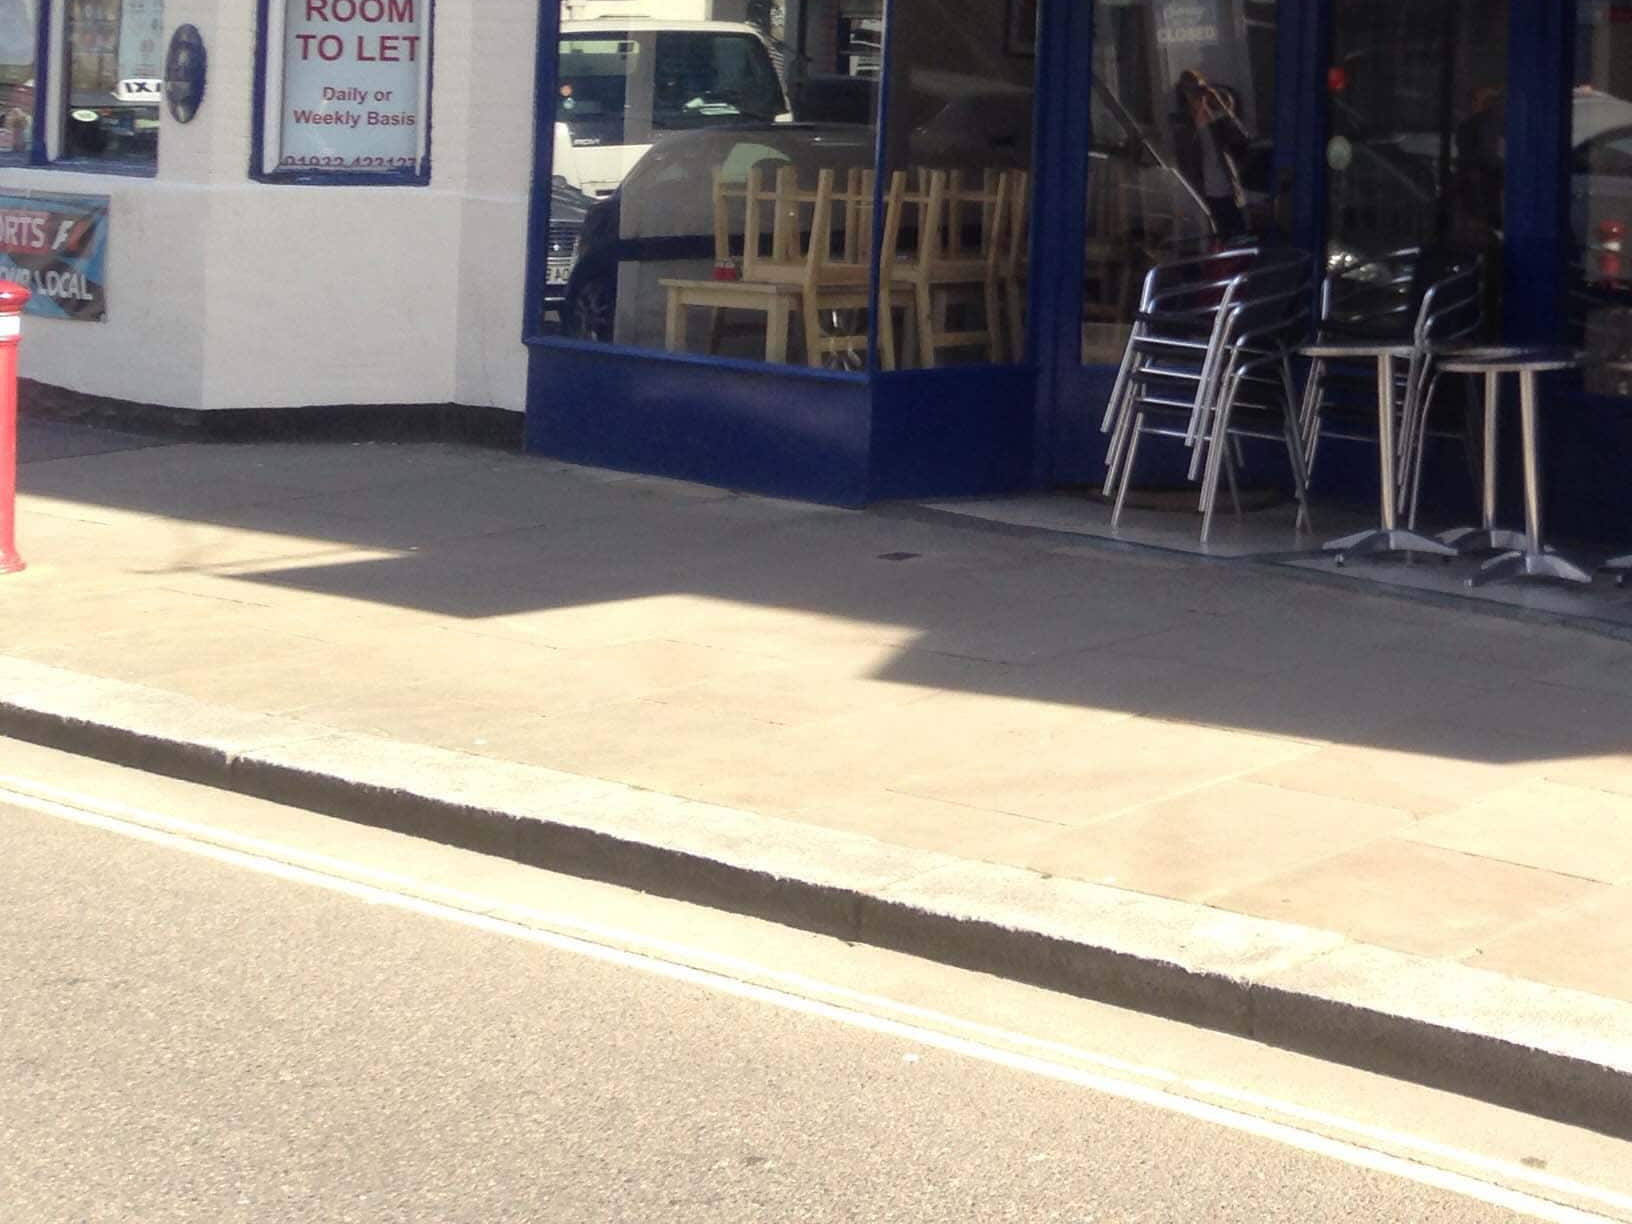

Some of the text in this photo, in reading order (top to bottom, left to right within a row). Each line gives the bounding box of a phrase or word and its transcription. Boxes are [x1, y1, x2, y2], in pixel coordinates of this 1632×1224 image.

[295, 34, 421, 62] TO LET
[322, 86, 393, 105] Daily or
[293, 110, 416, 128] Weekly Basis
[33, 269, 94, 300] LOCAL
